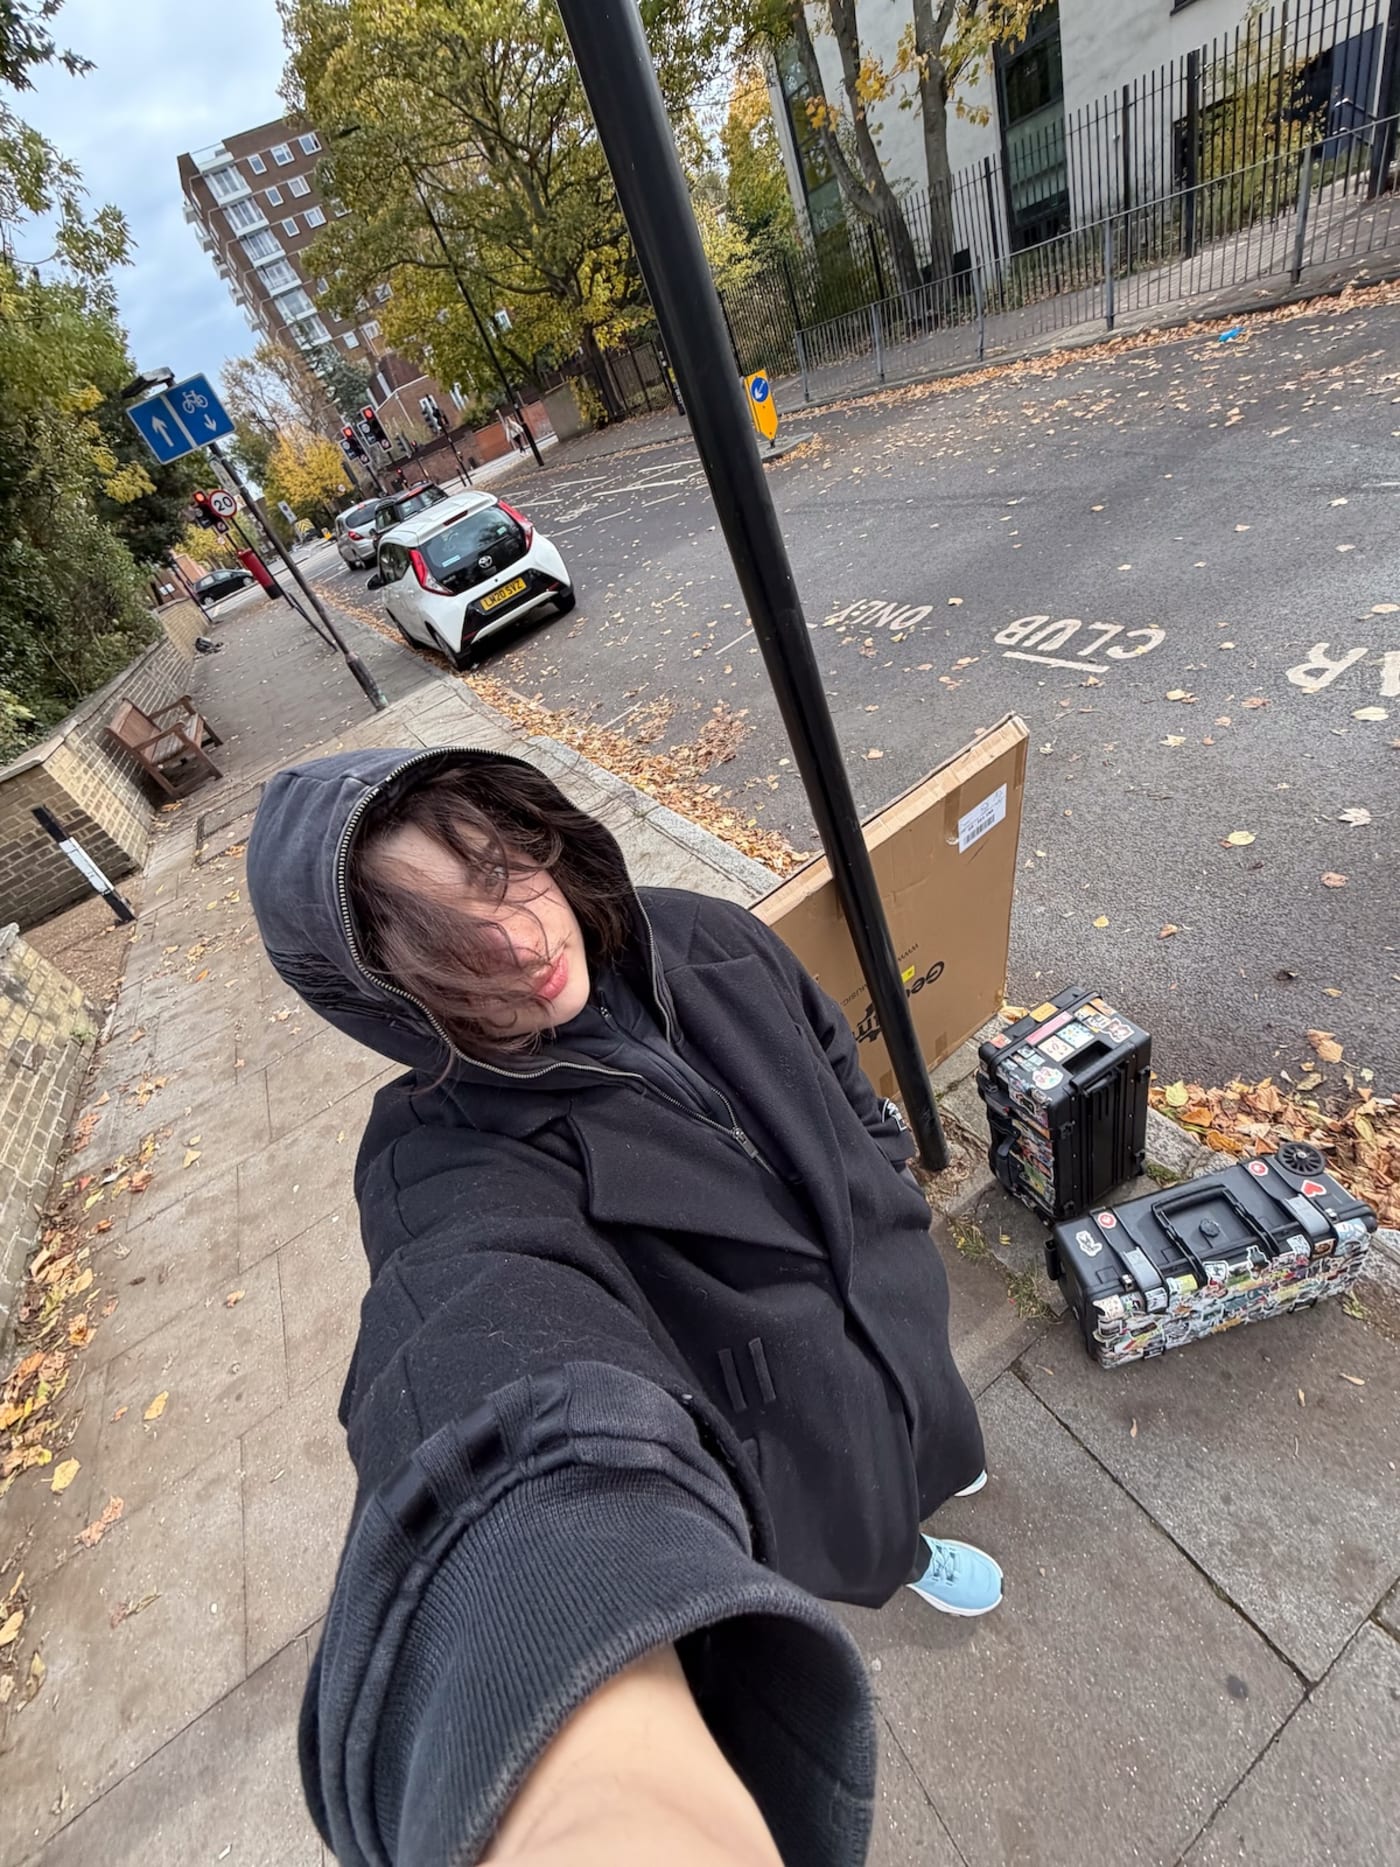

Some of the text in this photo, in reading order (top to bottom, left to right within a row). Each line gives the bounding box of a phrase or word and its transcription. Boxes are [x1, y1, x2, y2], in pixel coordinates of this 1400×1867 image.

[214, 496, 233, 512] 20
[823, 599, 934, 631] ONLY
[994, 615, 1166, 659] CLUB
